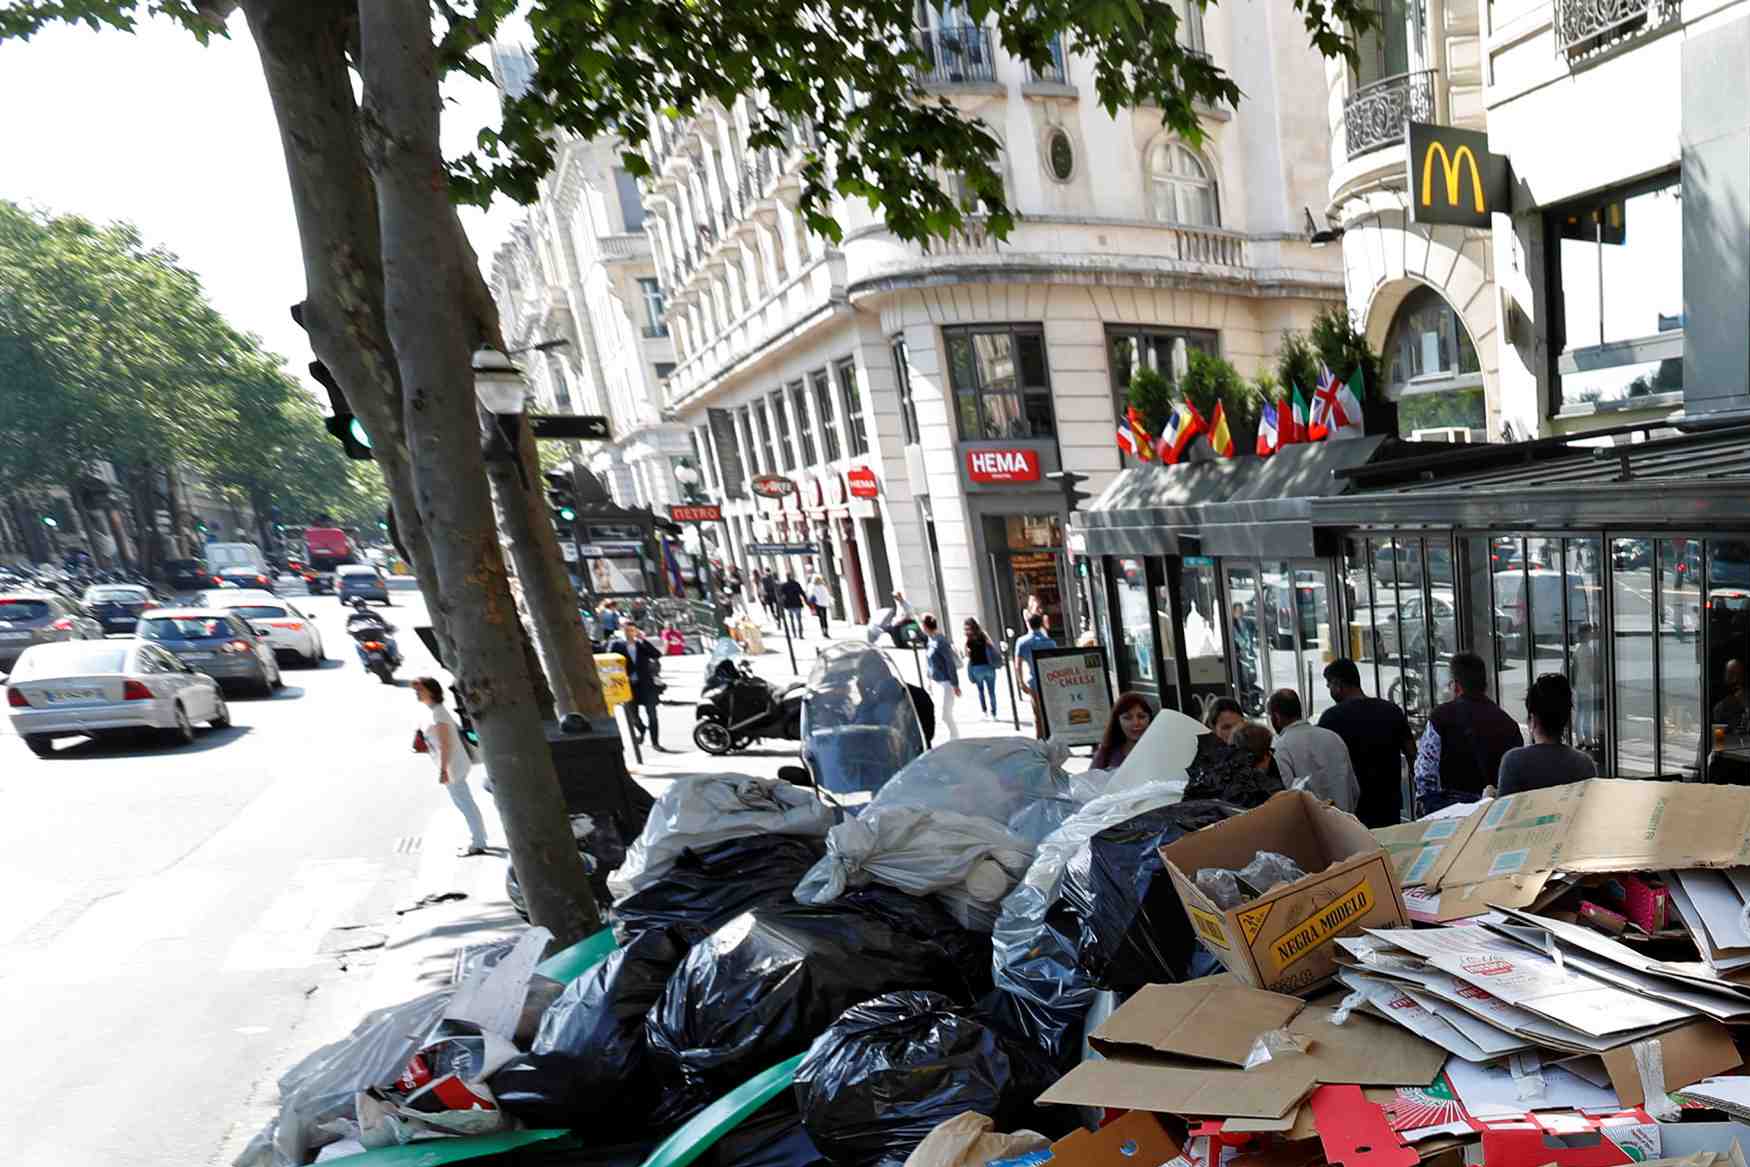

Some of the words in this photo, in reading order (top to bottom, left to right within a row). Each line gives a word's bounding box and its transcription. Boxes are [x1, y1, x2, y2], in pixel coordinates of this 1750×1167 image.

[971, 452, 1029, 473] HEMA
[1278, 925, 1319, 961] NEGRA
[1319, 890, 1367, 933] MODELO
